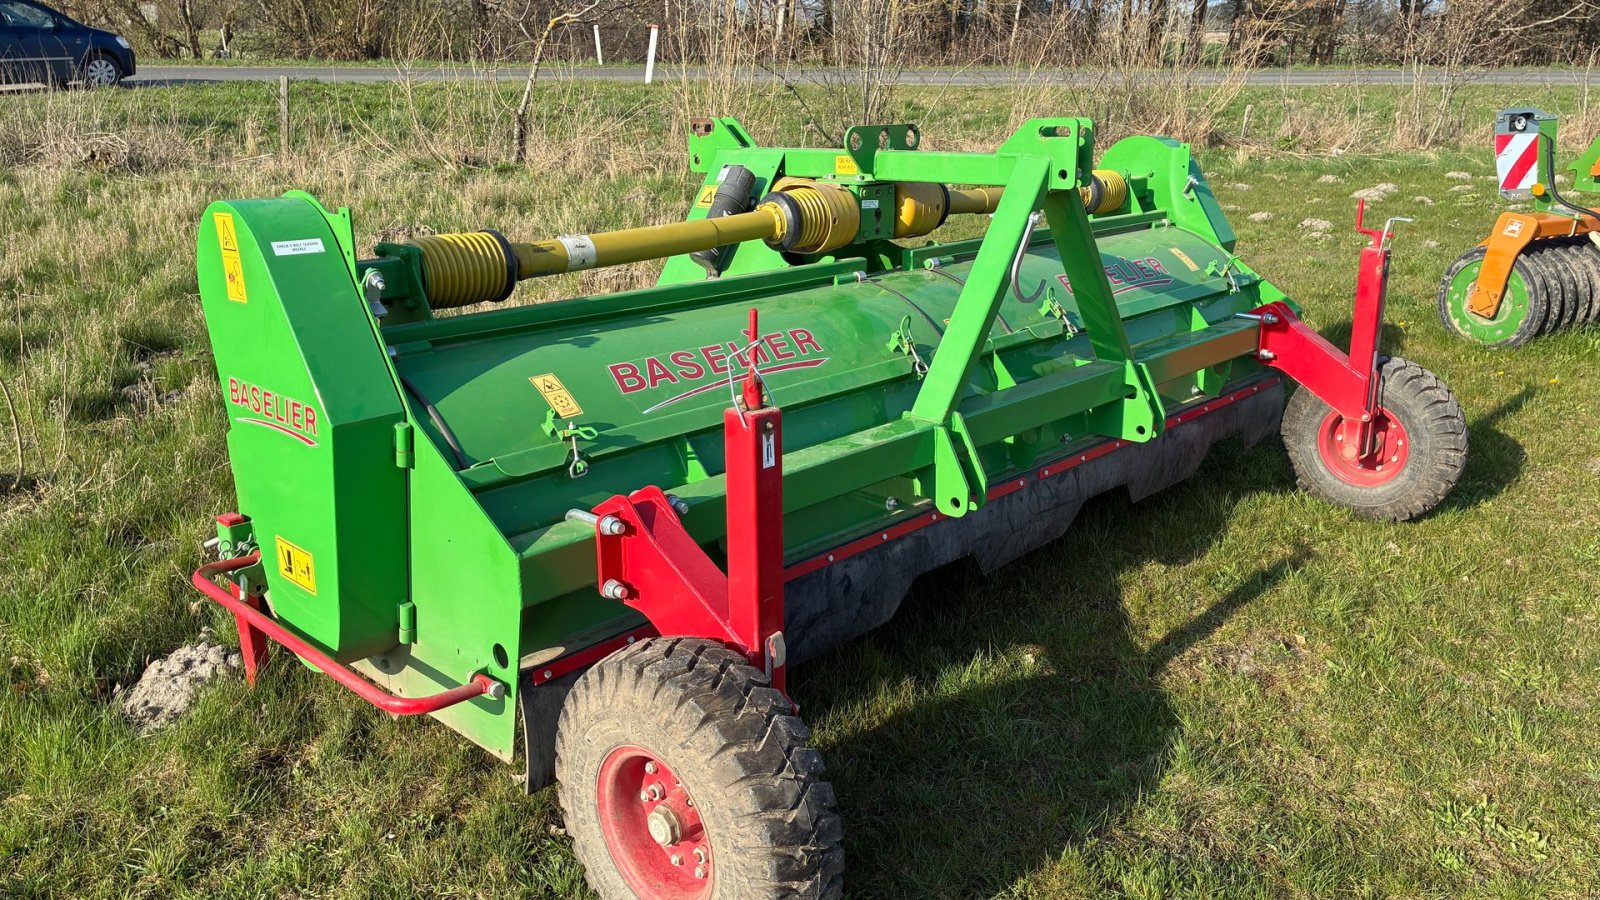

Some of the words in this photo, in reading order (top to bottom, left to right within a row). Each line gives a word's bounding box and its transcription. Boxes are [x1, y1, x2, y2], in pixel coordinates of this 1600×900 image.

[1056, 257, 1169, 294] BELIER
[608, 328, 823, 394] BASELIER
[229, 377, 318, 436] BASELIER
